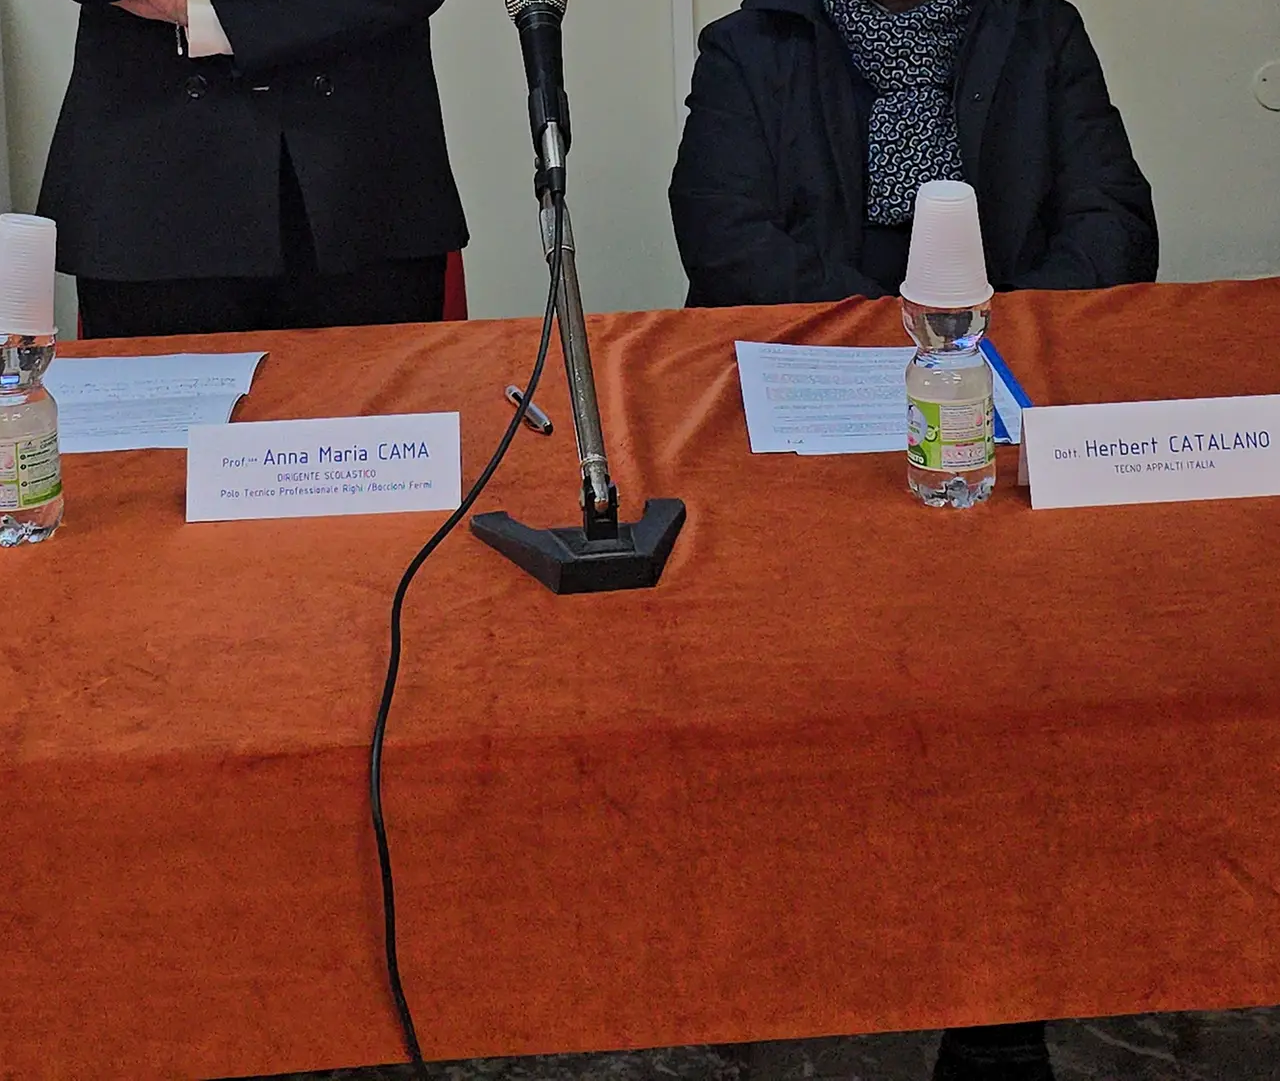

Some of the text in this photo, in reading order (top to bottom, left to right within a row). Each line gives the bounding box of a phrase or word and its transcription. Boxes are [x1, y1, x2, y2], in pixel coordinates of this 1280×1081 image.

[263, 448, 309, 466] Anna
[319, 444, 368, 464] Maria
[378, 441, 430, 461] CAMA
[1054, 430, 1270, 460] Dott. Herbert CATALANO
[276, 469, 376, 483] DIRIGENTE SCOLASTICO
[1114, 460, 1216, 474] TECNO APPALTI ITALIA
[220, 480, 433, 499] Polo Tecnico Professionale Righi /Boccioni Fermi
